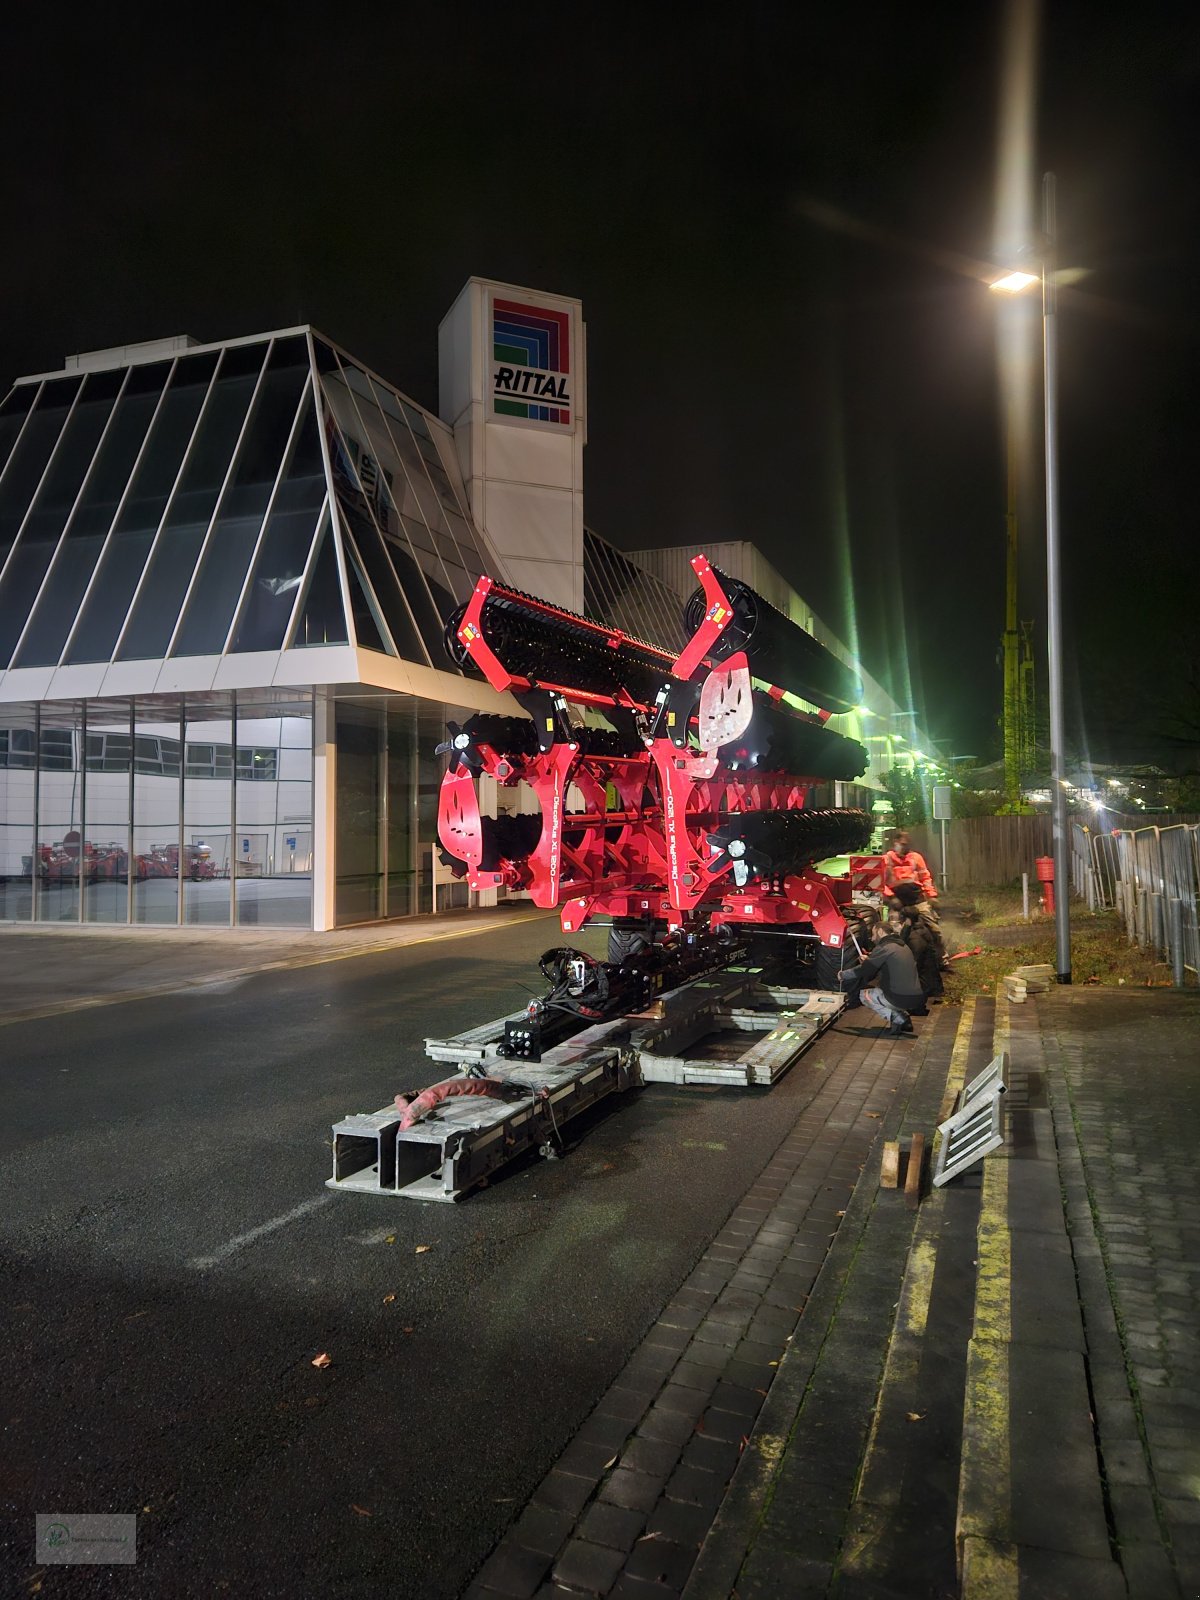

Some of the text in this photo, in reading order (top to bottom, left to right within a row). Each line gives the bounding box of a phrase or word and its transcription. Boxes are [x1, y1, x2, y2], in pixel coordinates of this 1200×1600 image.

[494, 367, 570, 400] RITTAL
[669, 820, 675, 832] XL
[552, 841, 558, 852] XL
